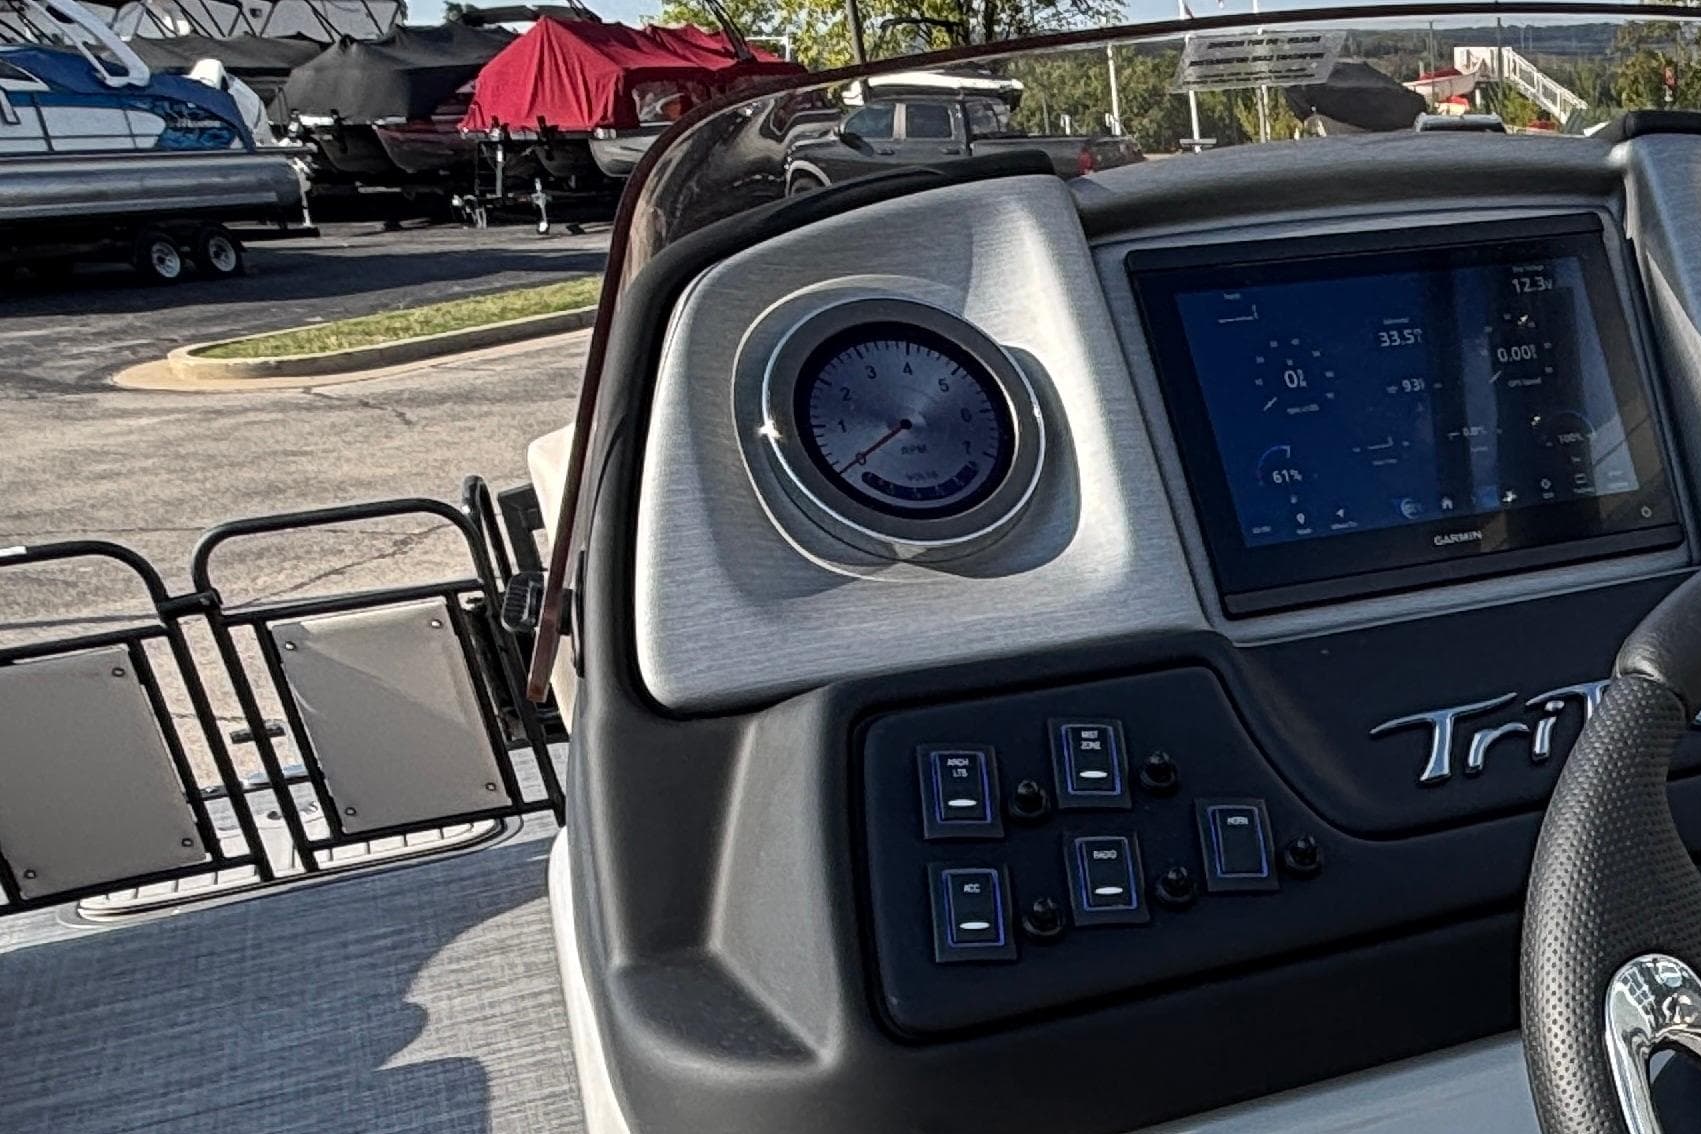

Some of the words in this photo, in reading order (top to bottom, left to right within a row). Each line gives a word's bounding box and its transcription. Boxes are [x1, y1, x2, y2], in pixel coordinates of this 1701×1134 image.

[867, 366, 877, 379] 3
[903, 362, 913, 376] 4
[938, 379, 950, 393] 5
[840, 387, 850, 401] 2
[1434, 530, 1483, 546] GARMIN
[963, 883, 981, 893] ACC
